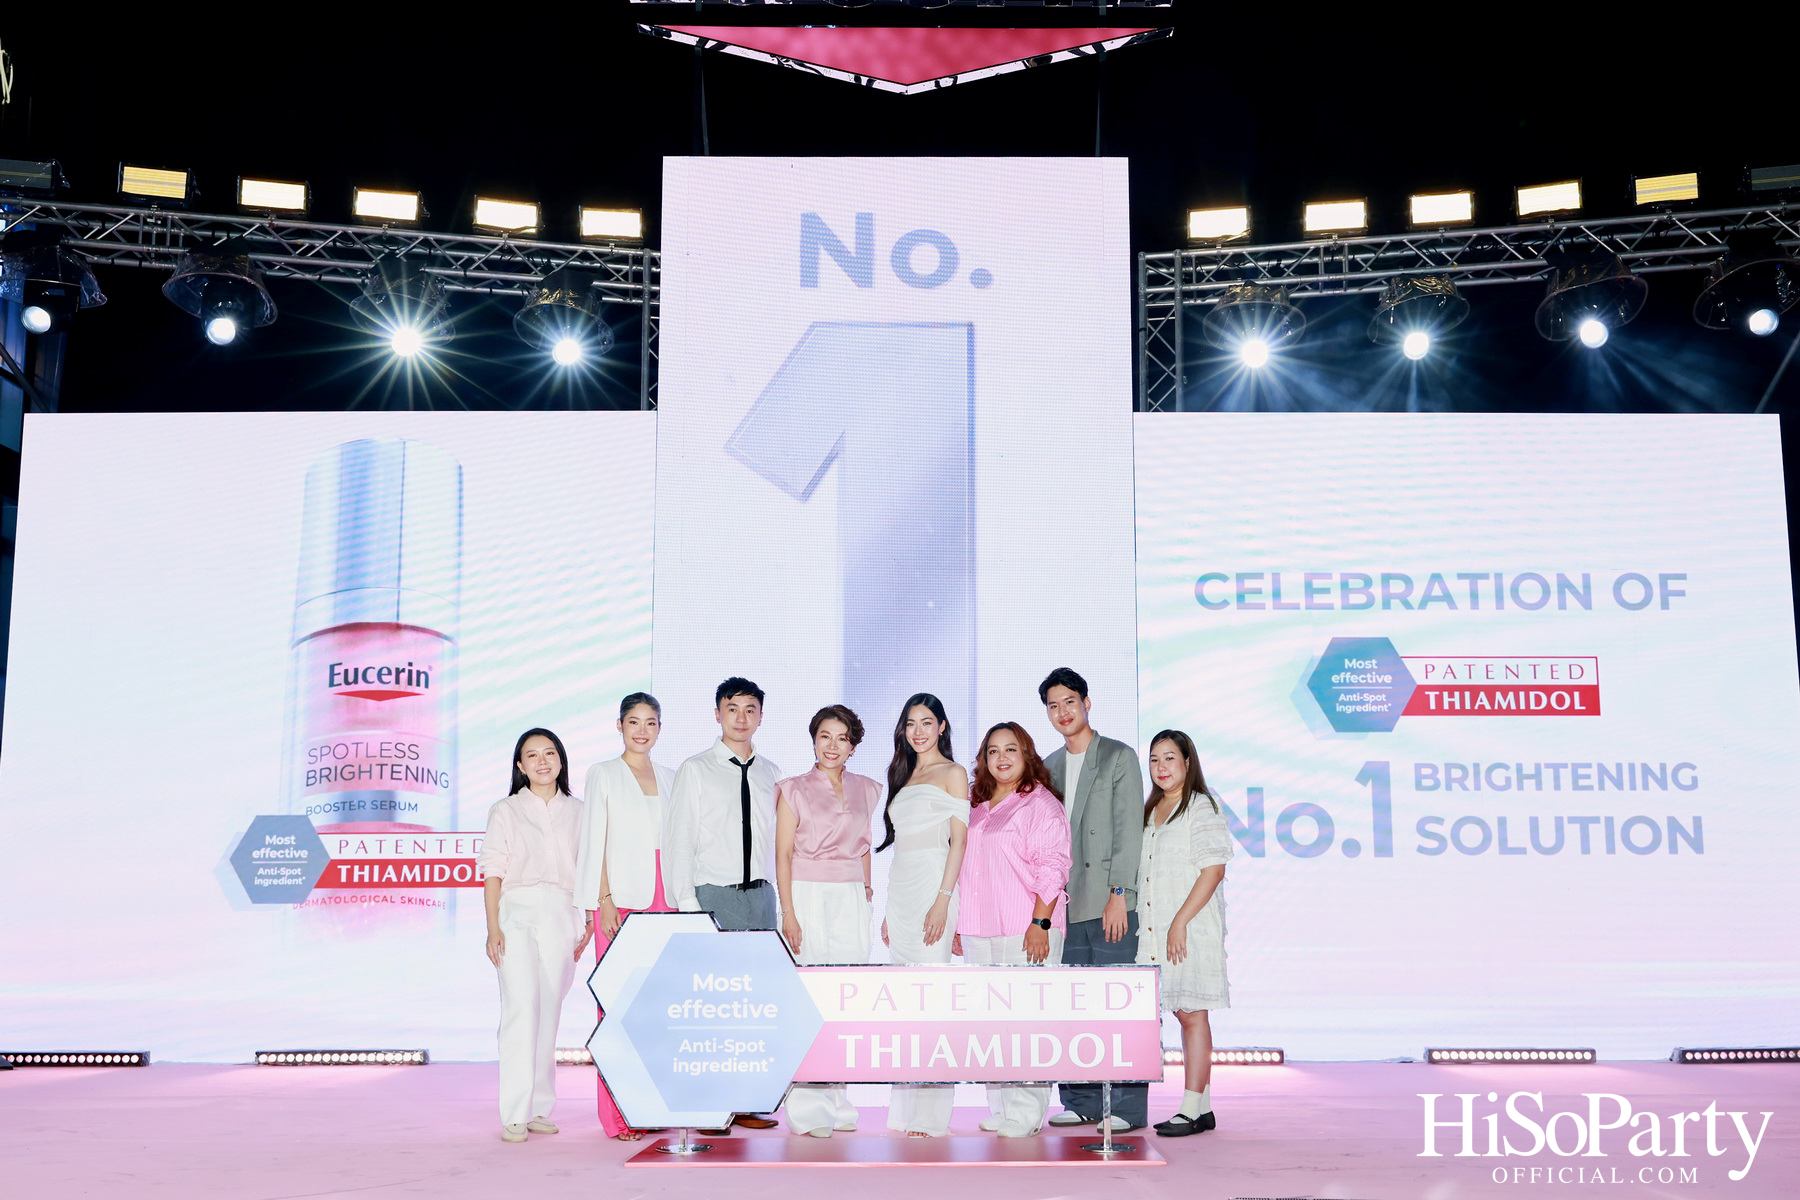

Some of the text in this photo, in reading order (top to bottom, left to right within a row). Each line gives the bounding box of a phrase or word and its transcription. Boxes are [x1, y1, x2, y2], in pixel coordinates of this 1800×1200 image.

[800, 212, 994, 289] No.
[1194, 571, 1687, 612] CELEBRATION OF
[1344, 658, 1377, 669] Most
[1424, 664, 1585, 680] PATENTED
[328, 661, 430, 689] Eucerin
[1331, 671, 1392, 684] effective
[1338, 692, 1386, 704] Anti-Spot
[1425, 691, 1586, 710] THIAMIDOL
[308, 741, 420, 765] SPOTLESS
[305, 763, 450, 789] BRIGHTENING
[1414, 761, 1699, 793] BRIGHTENING
[305, 799, 418, 816] BOOSTER SERUM
[265, 834, 297, 845] Most
[1415, 814, 1705, 856] SOLUTION
[252, 847, 309, 859] effective
[338, 838, 484, 854] PATENTED
[257, 866, 302, 877] Anti-Spot
[400, 895, 446, 910] SKINCARE
[693, 973, 753, 992] Most
[667, 997, 778, 1019] effective
[678, 1037, 766, 1056] Anti-Spot
[838, 1032, 1133, 1069] THIAMIDOL
